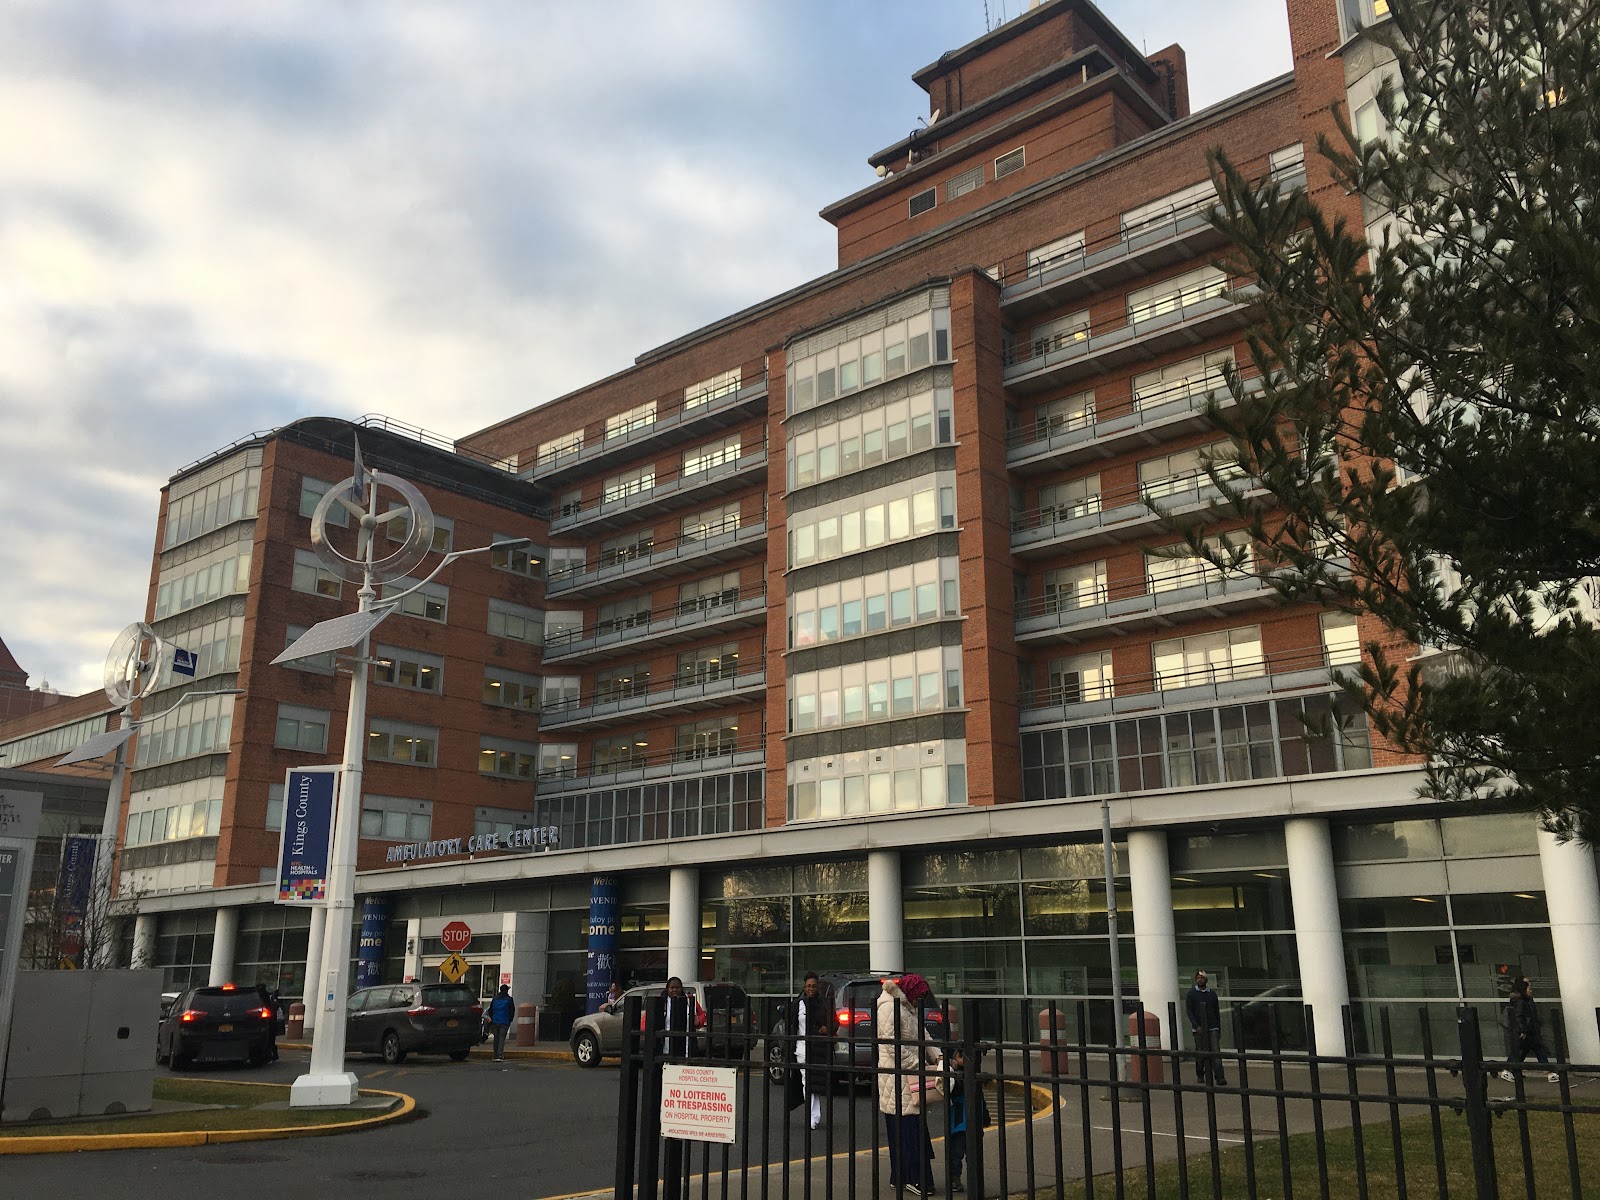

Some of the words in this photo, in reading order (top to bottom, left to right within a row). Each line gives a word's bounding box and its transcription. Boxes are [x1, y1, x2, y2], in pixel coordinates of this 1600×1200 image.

[295, 775, 312, 818] County
[291, 821, 308, 855] Kings
[386, 838, 461, 862] AMBULATORY
[468, 832, 499, 852] CARE
[506, 826, 558, 848] CENTER
[443, 930, 469, 942] STOP
[670, 1089, 681, 1098] NO
[684, 1090, 727, 1102] LOITERING
[664, 1099, 675, 1108] OR
[677, 1100, 733, 1113] TRESPASSING
[665, 1111, 673, 1119] ON
[674, 1112, 699, 1121] HOSPITAL
[701, 1114, 731, 1123] PROPERTY
